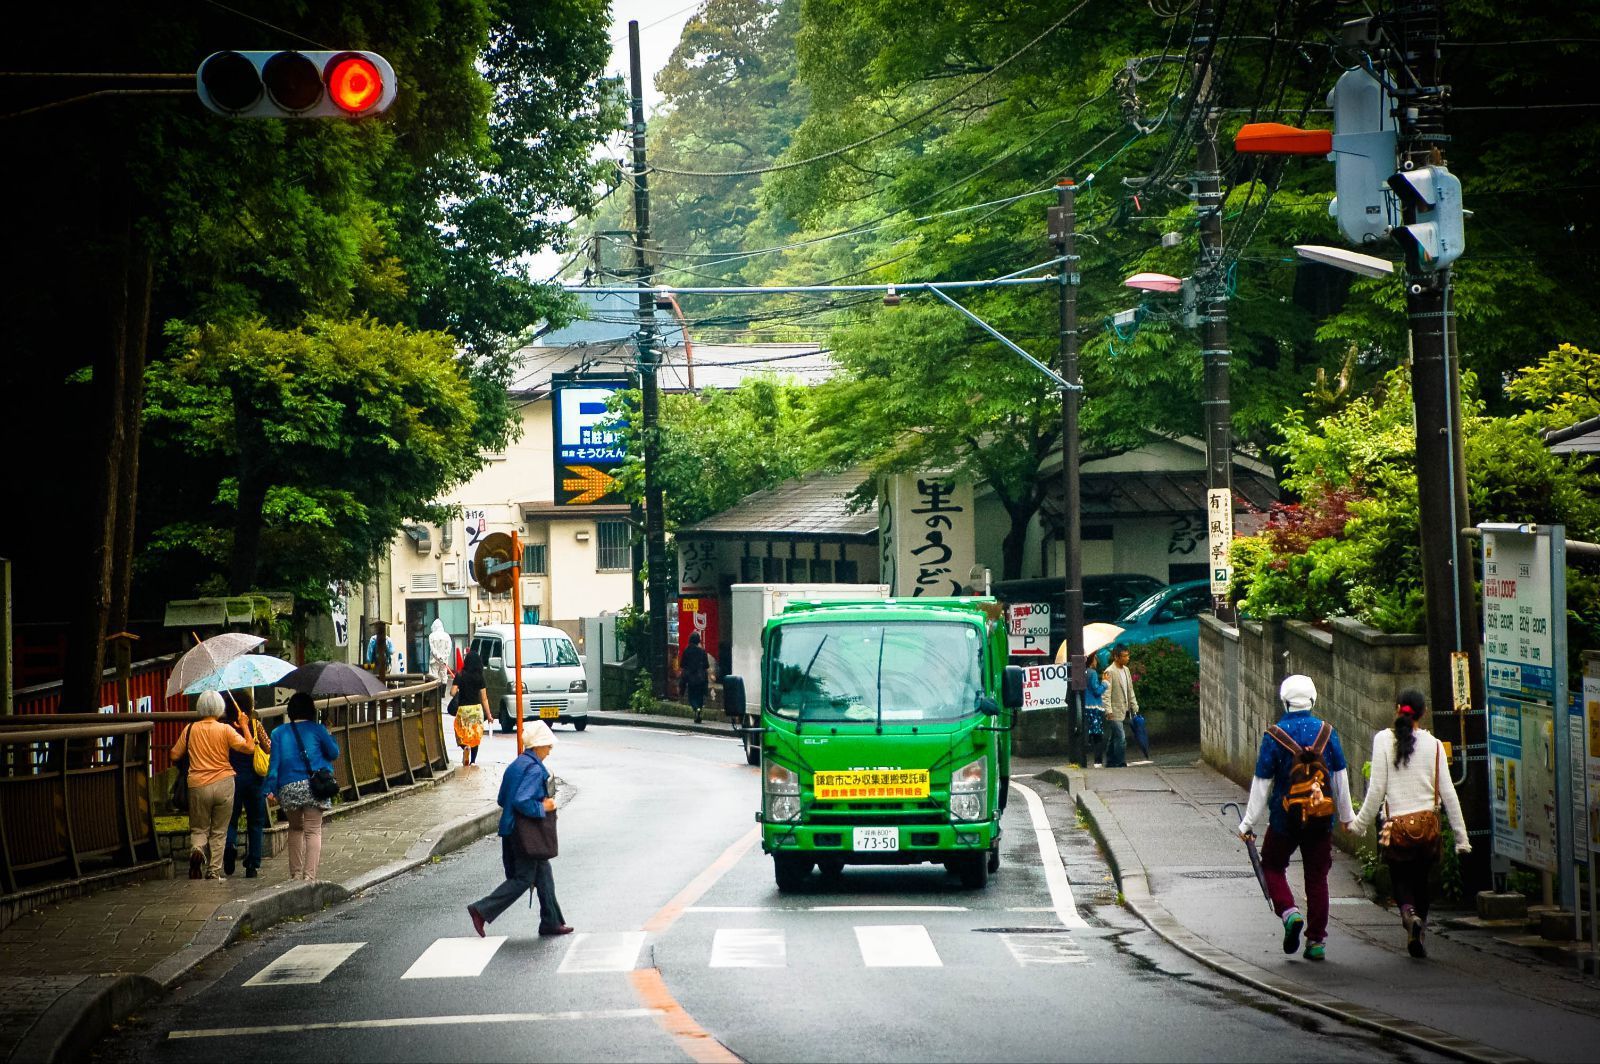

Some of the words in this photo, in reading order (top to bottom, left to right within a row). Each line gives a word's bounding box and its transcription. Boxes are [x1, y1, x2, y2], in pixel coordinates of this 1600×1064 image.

[1210, 494, 1224, 560] 有風亭
[682, 542, 701, 583] うどん
[1024, 636, 1035, 648] P
[1039, 697, 1061, 706] ¥500
[816, 773, 927, 786] 鎌倉市ごみ収集運搬受託車
[863, 837, 897, 849] 73-50
